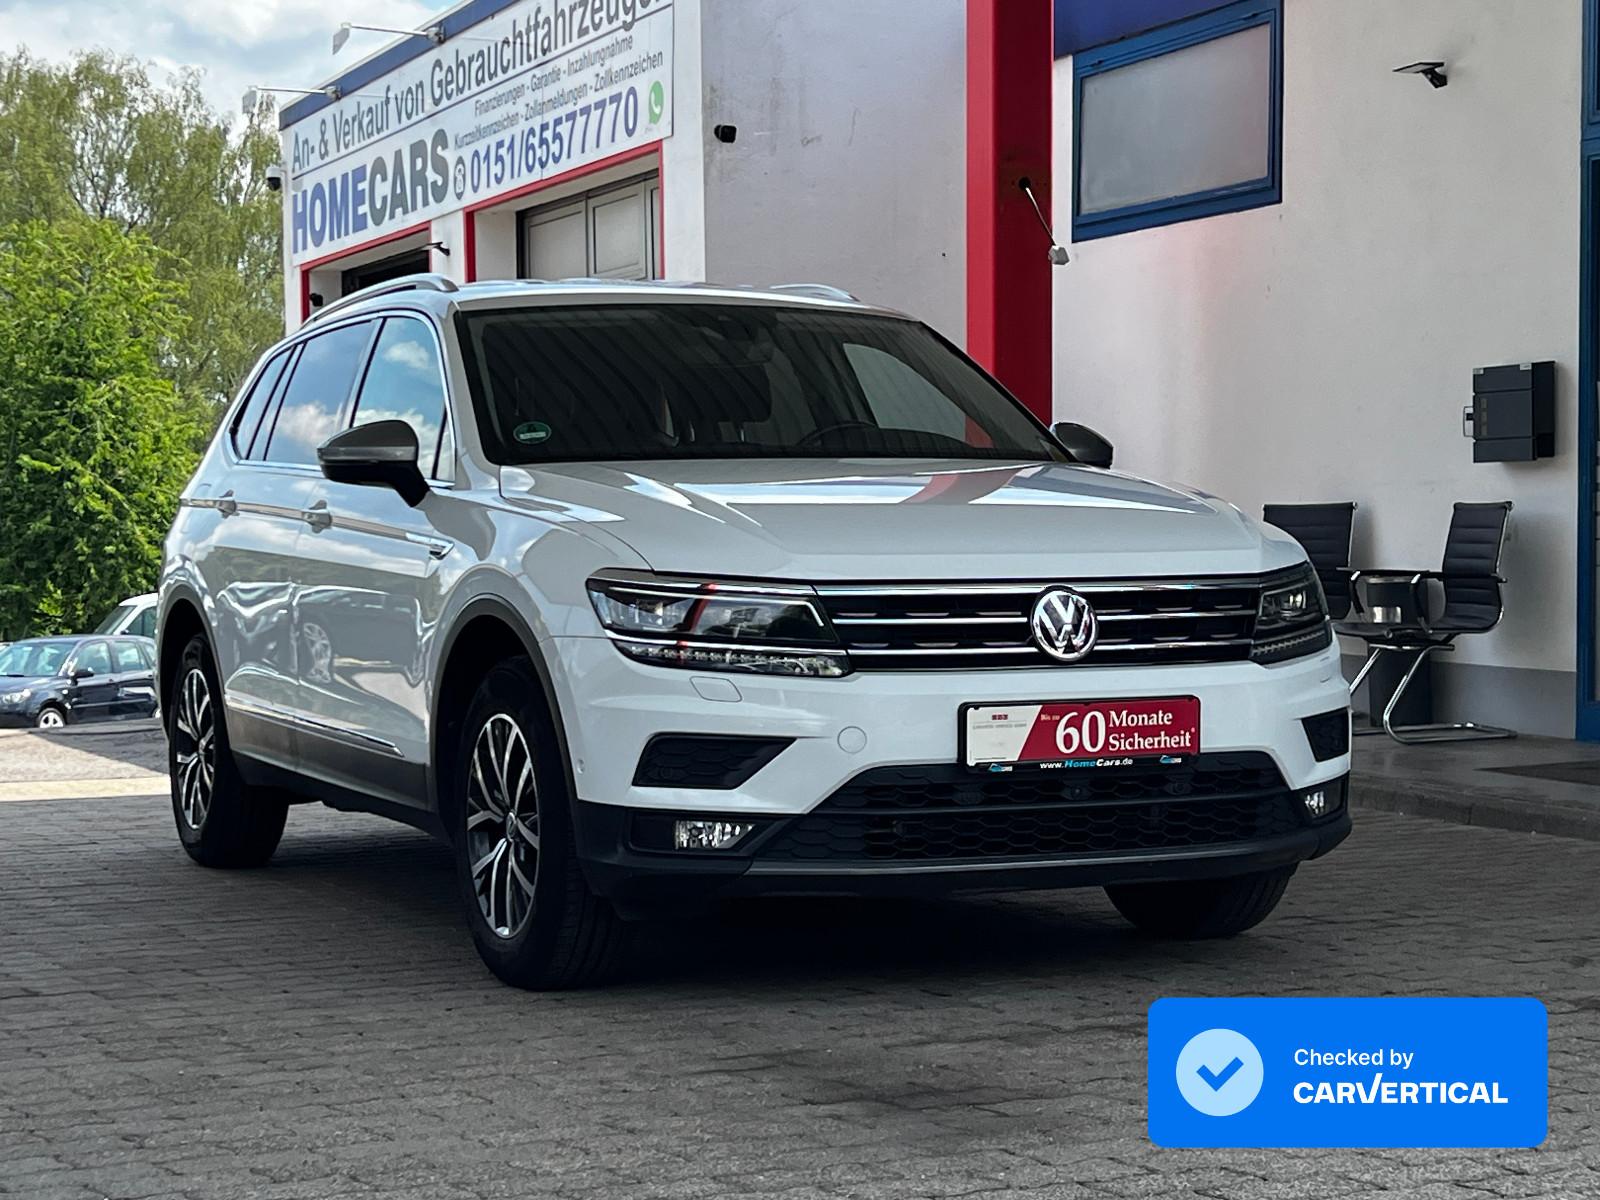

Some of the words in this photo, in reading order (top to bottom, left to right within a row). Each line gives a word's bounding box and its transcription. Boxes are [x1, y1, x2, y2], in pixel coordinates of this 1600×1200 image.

[291, 131, 315, 174] An-
[319, 118, 329, 161] &
[332, 84, 391, 153] Verkauf
[395, 79, 425, 125] von
[430, 0, 661, 108] Gebrauchtfahrzeug
[530, 66, 561, 92] Garantie
[567, 35, 633, 76] Inzahlungnahme
[594, 50, 663, 93] Zollkennzeichen
[470, 86, 638, 194] 0151/65577770
[292, 128, 449, 254] HOMECARS
[1055, 710, 1106, 754] 60
[1108, 709, 1173, 728] Monate
[1040, 757, 1134, 769] www.HomeCars.de
